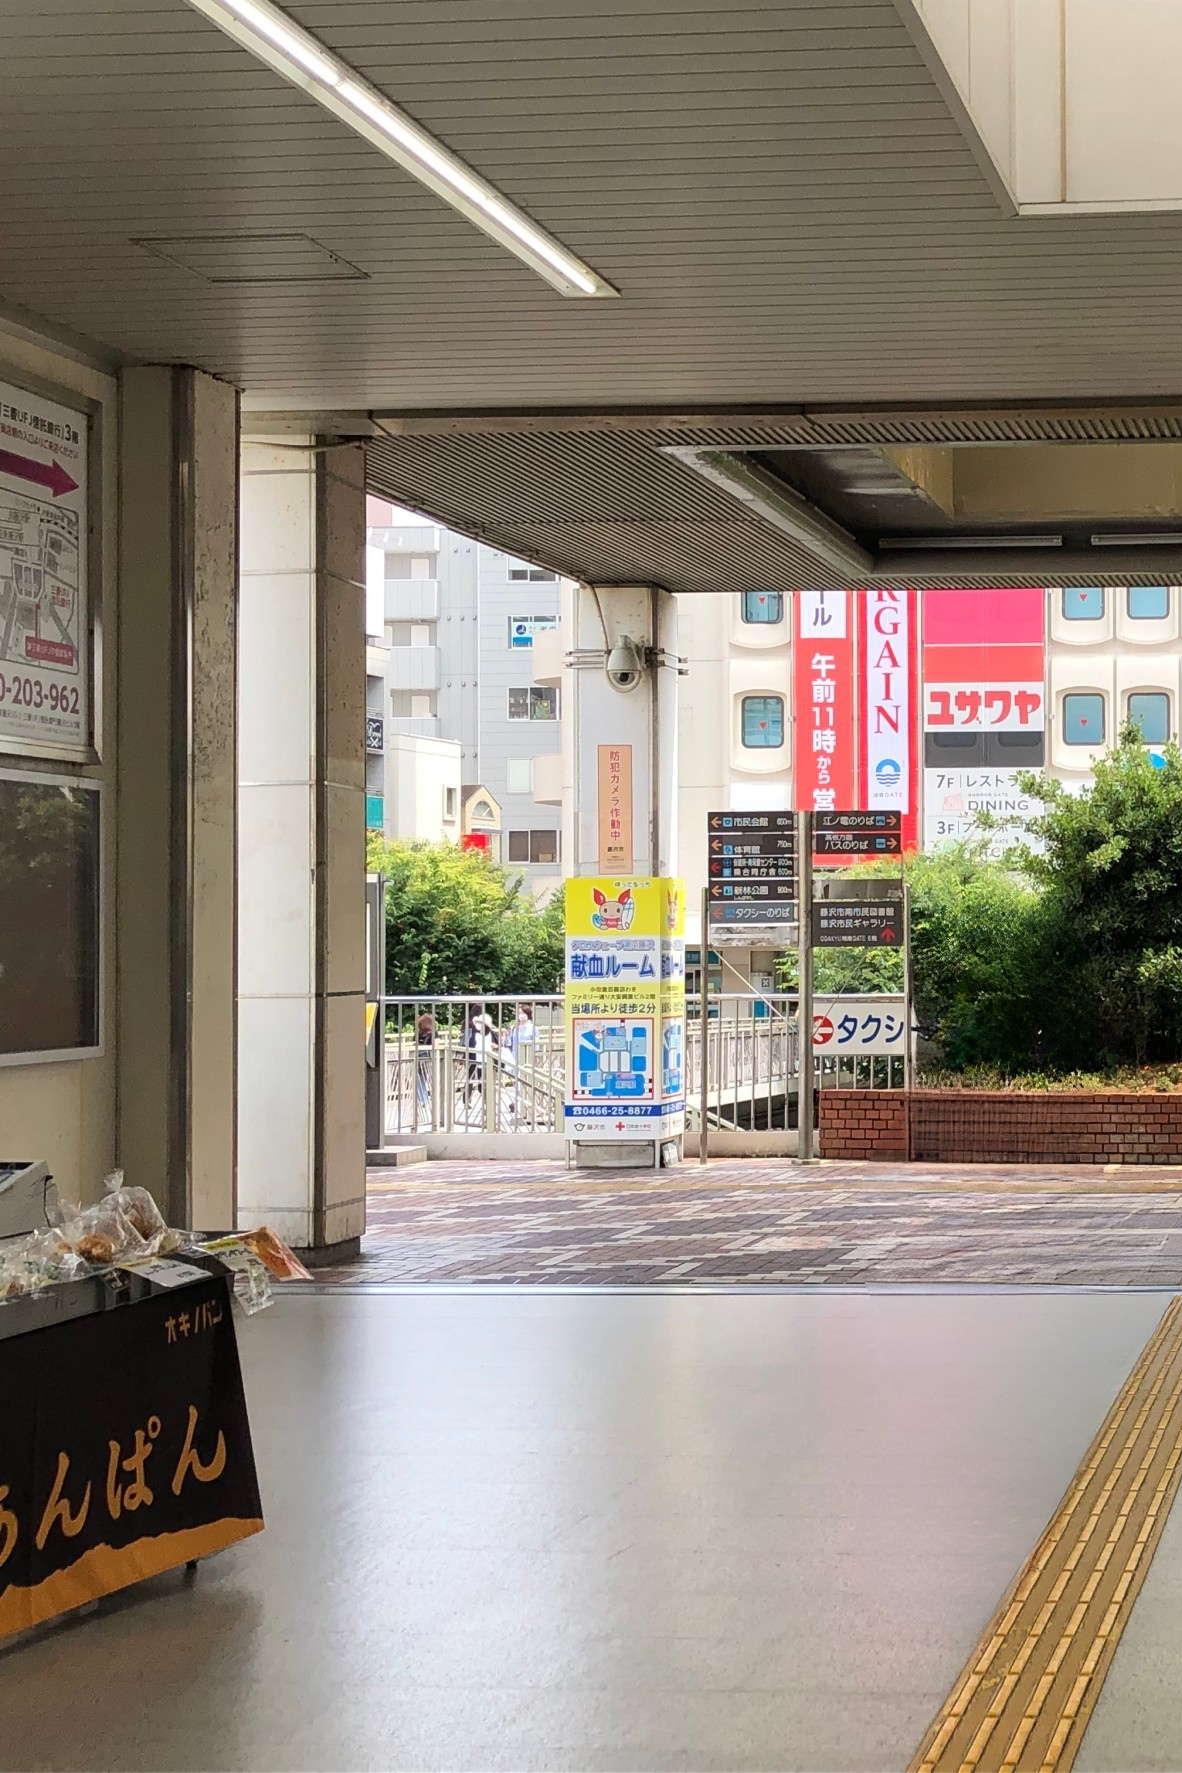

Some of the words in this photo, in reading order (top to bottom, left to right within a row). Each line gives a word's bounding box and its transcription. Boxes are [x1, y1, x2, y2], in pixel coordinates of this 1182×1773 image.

[937, 775, 954, 788] 7F
[967, 775, 1019, 787] レストラ
[610, 751, 620, 840] 防犯カメラ作動中
[968, 801, 1029, 810] DINING
[734, 818, 768, 827] 市民会館
[823, 816, 874, 826] 江ノ電のりば
[937, 821, 955, 834] 3F
[734, 846, 760, 854] 体育館
[825, 841, 868, 850] バスのりば
[734, 886, 768, 895] 新林公園
[736, 908, 790, 918] タクシーのりば
[820, 919, 894, 928] 藤沢市民ギャラリー
[571, 954, 656, 979] 献血ルーム
[571, 1003, 656, 1014] 当場所より徒歩2分
[837, 1014, 904, 1044] タクシ
[583, 1106, 653, 1115] 0466-25-8877
